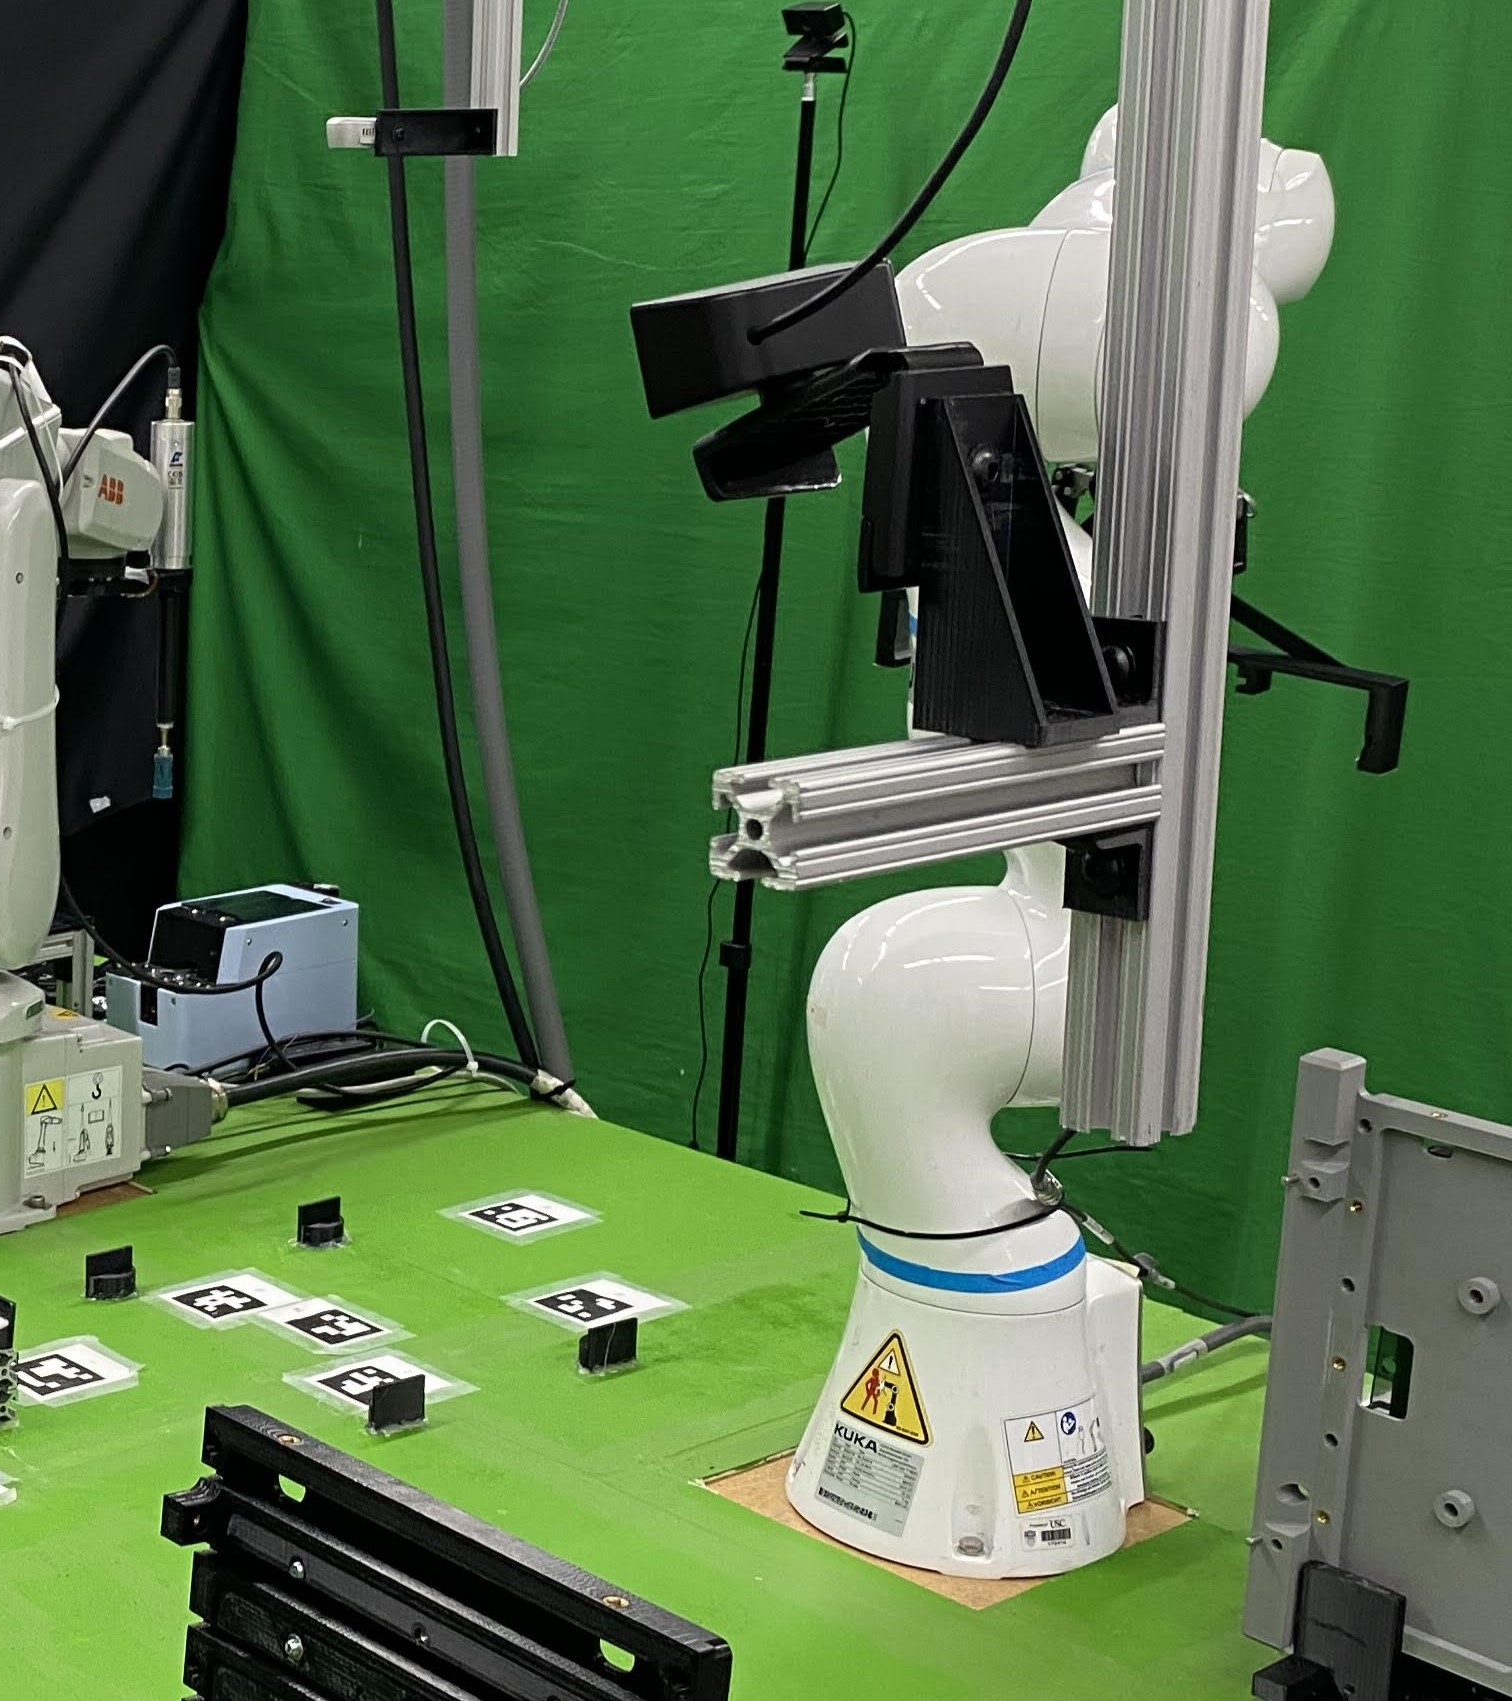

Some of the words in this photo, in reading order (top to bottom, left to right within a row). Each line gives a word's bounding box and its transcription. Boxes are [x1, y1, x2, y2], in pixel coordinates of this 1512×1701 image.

[97, 474, 124, 505] ABB
[834, 1423, 878, 1454] KUKA
[1049, 1519, 1066, 1529] USC
